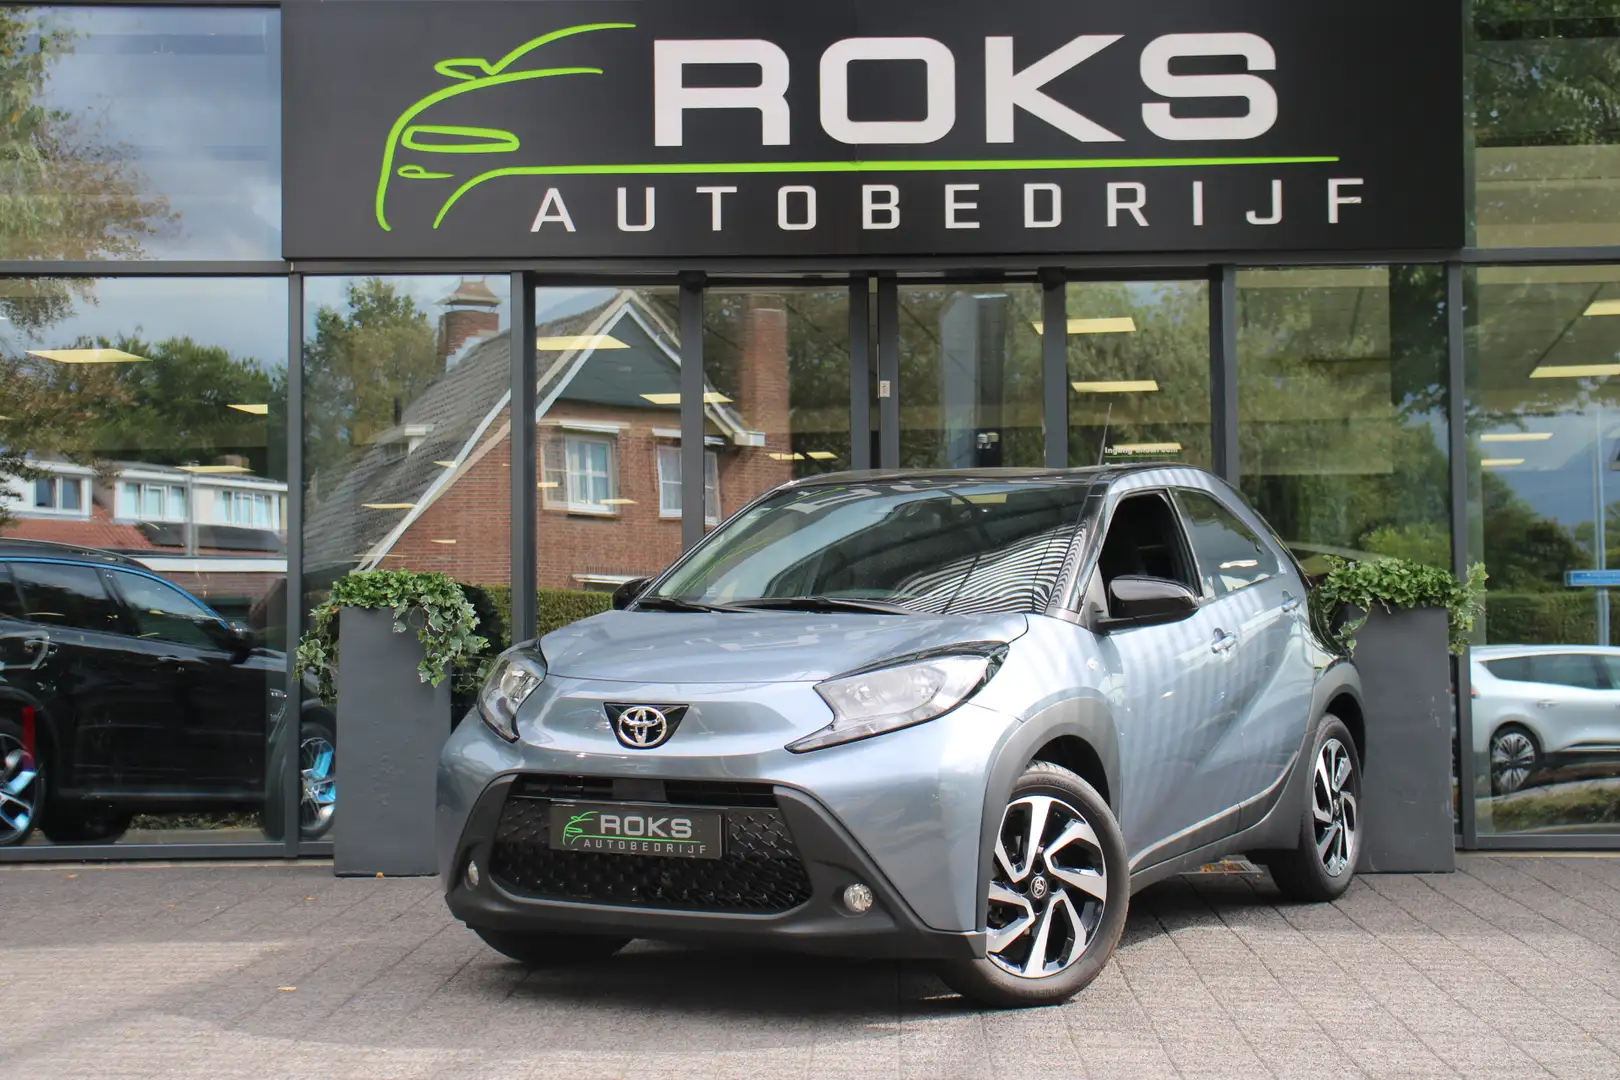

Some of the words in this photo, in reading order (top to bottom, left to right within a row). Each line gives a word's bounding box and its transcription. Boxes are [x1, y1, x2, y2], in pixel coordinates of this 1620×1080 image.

[654, 32, 1279, 147] ROKS
[530, 178, 1365, 233] AUTOBEDRIJF
[600, 814, 692, 838] ROKS
[584, 839, 707, 854] AUTOBEDRIJF
